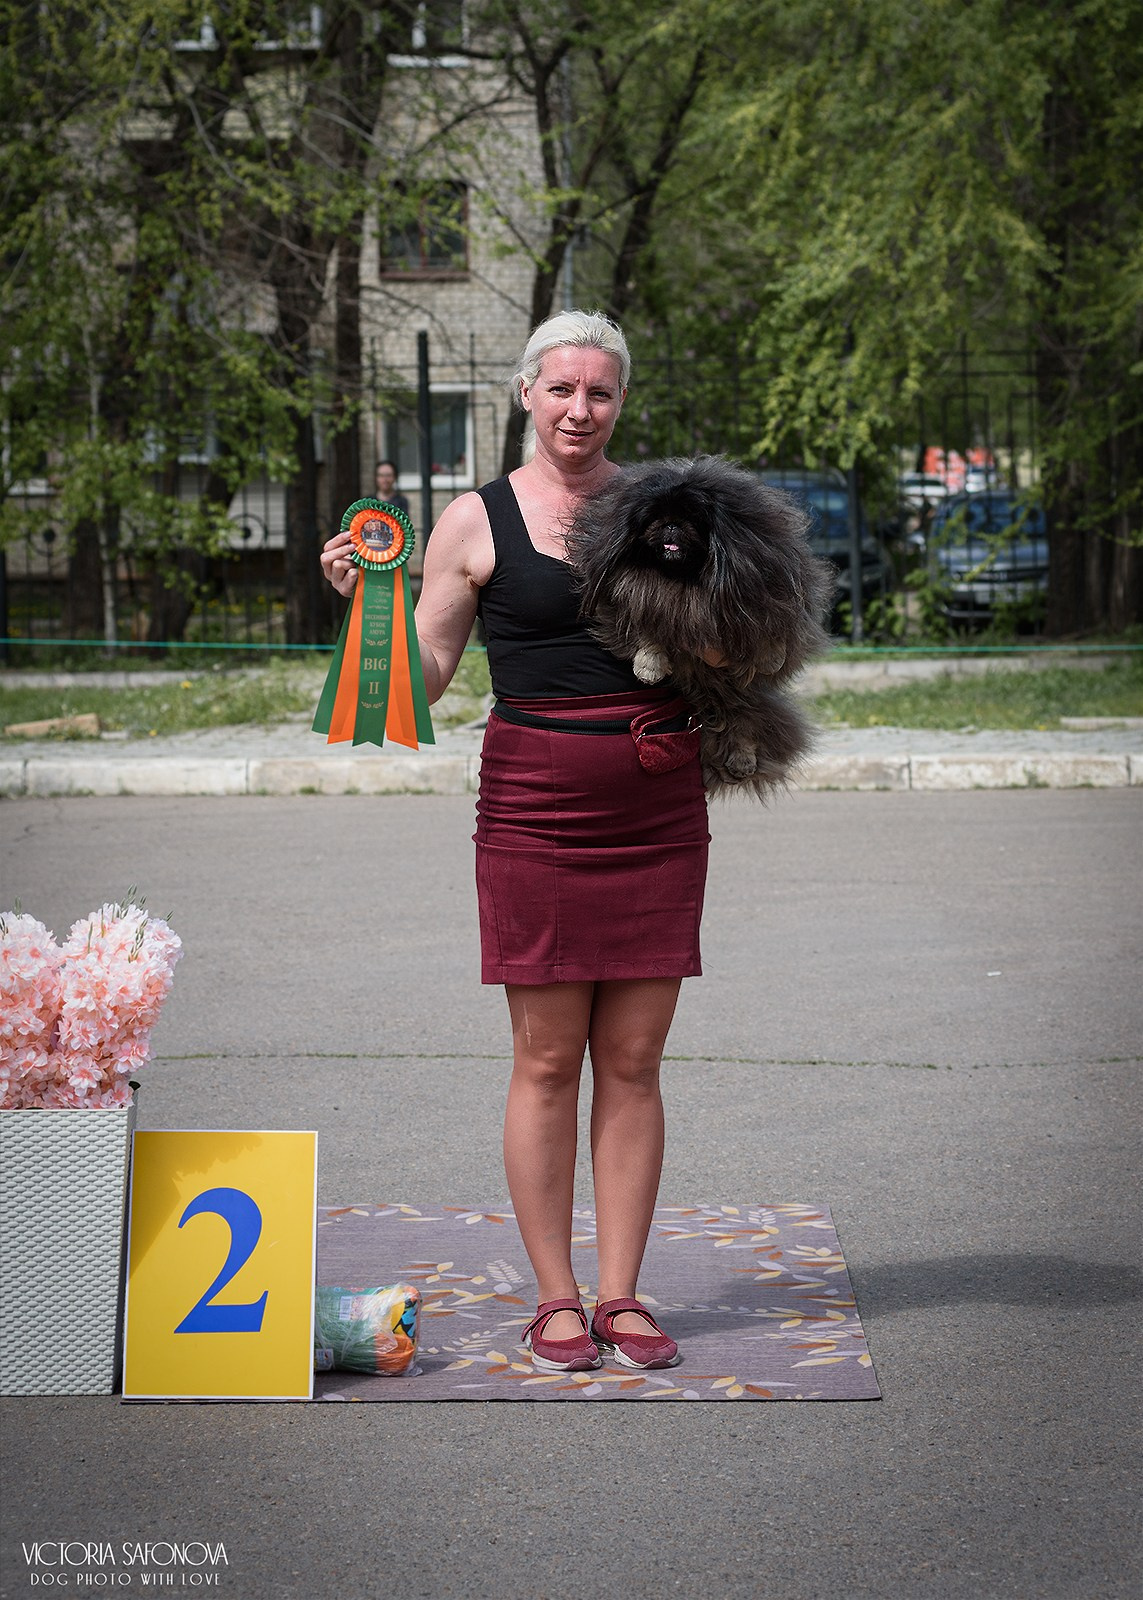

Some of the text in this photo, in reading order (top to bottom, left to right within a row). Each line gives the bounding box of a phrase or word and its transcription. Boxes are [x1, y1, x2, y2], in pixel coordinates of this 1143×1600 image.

[363, 657, 387, 671] BIG
[368, 681, 380, 695] II
[173, 1187, 269, 1333] 2
